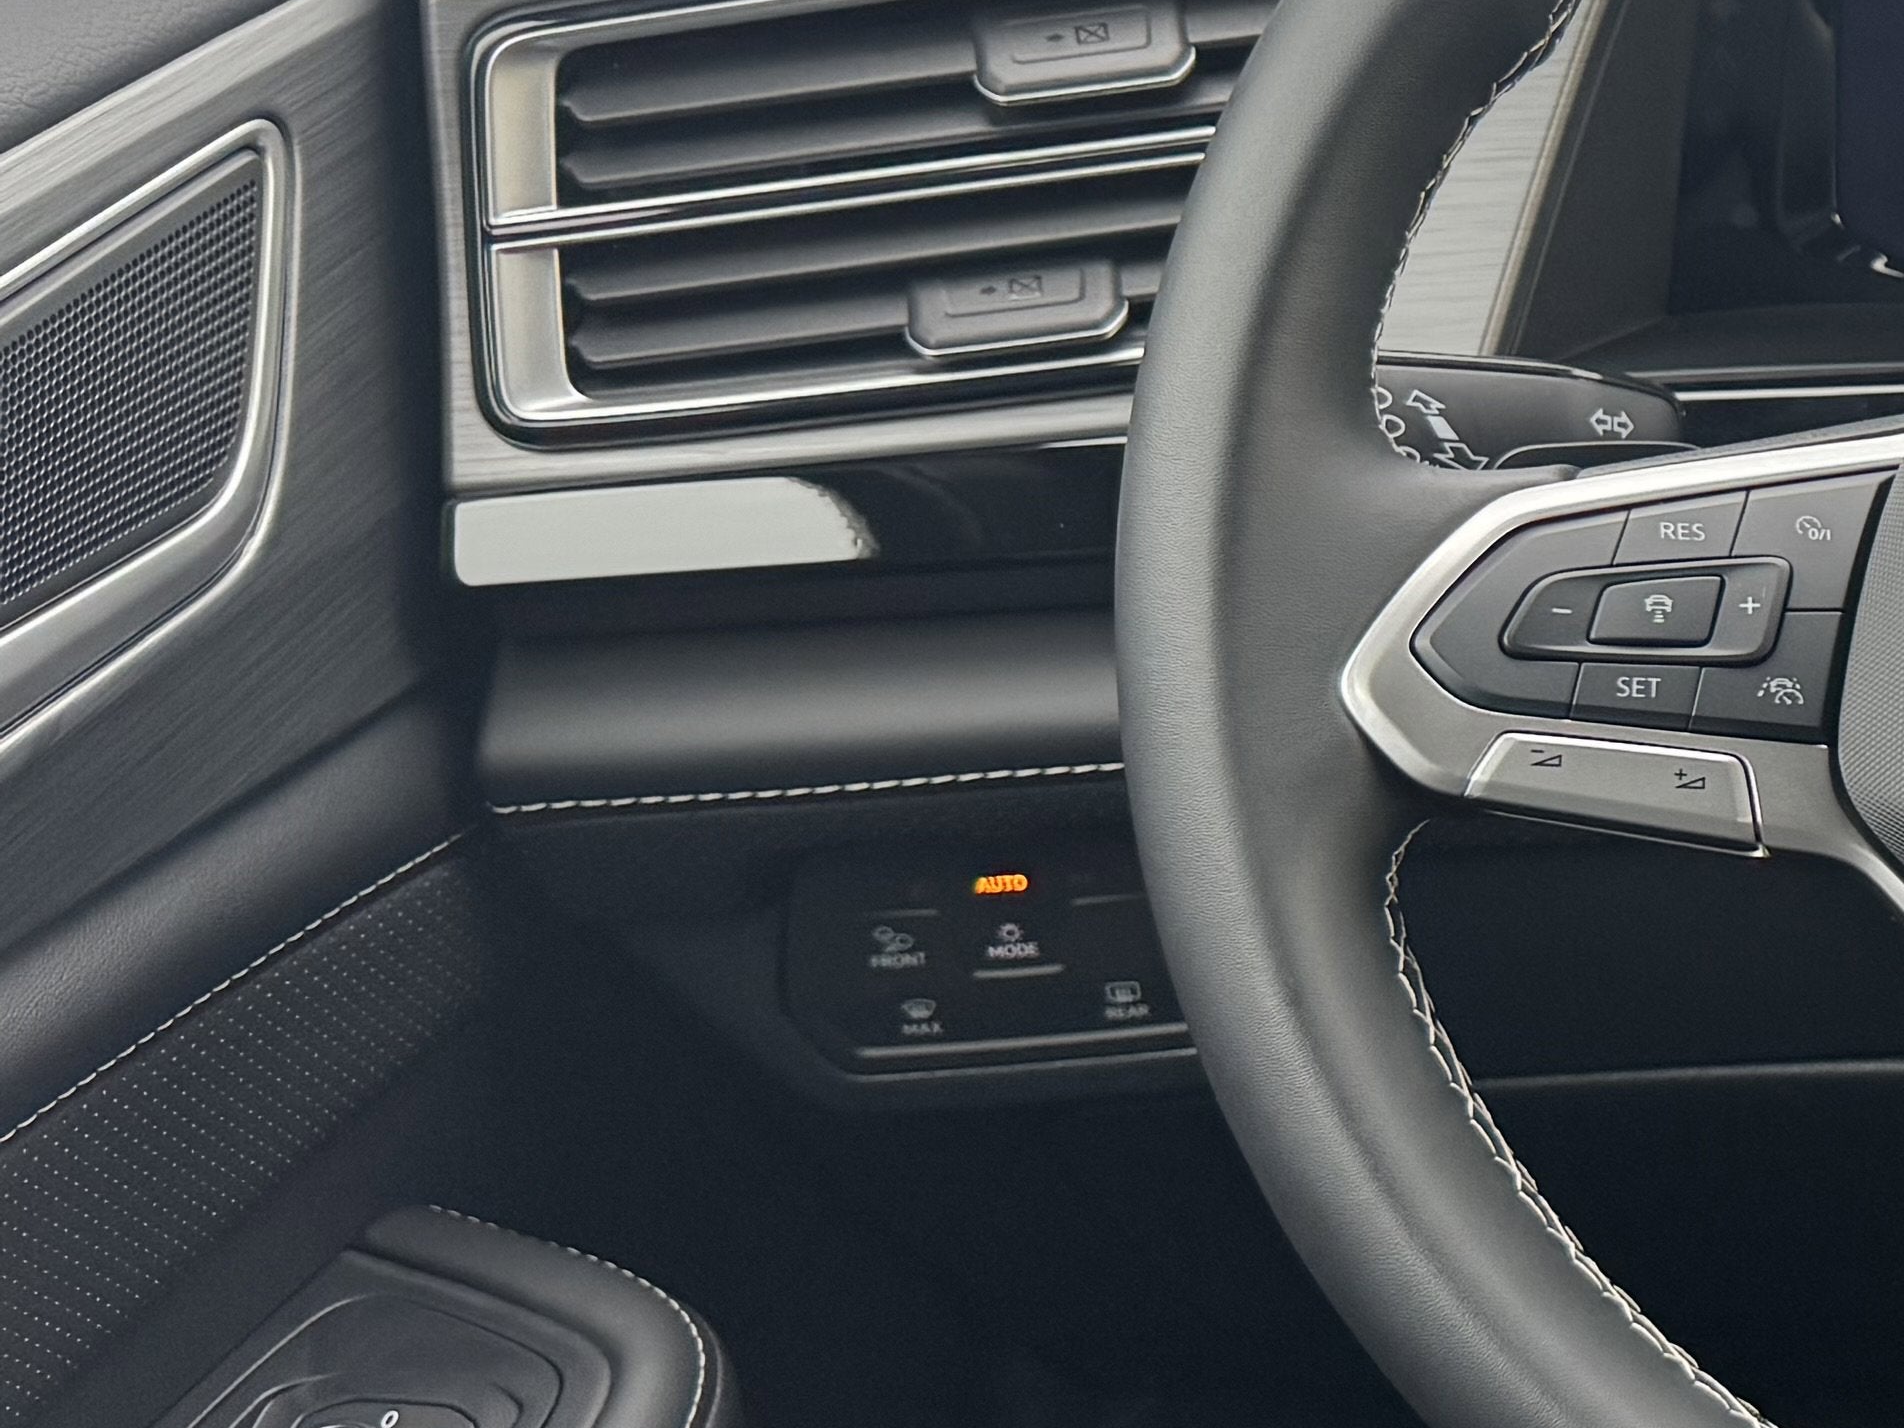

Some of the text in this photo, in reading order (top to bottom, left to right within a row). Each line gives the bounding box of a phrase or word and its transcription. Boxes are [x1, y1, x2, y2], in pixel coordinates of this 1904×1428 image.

[1659, 521, 1706, 542] RES
[1615, 676, 1662, 699] SET
[974, 874, 1029, 895] AUTO
[987, 941, 1039, 959] MODE
